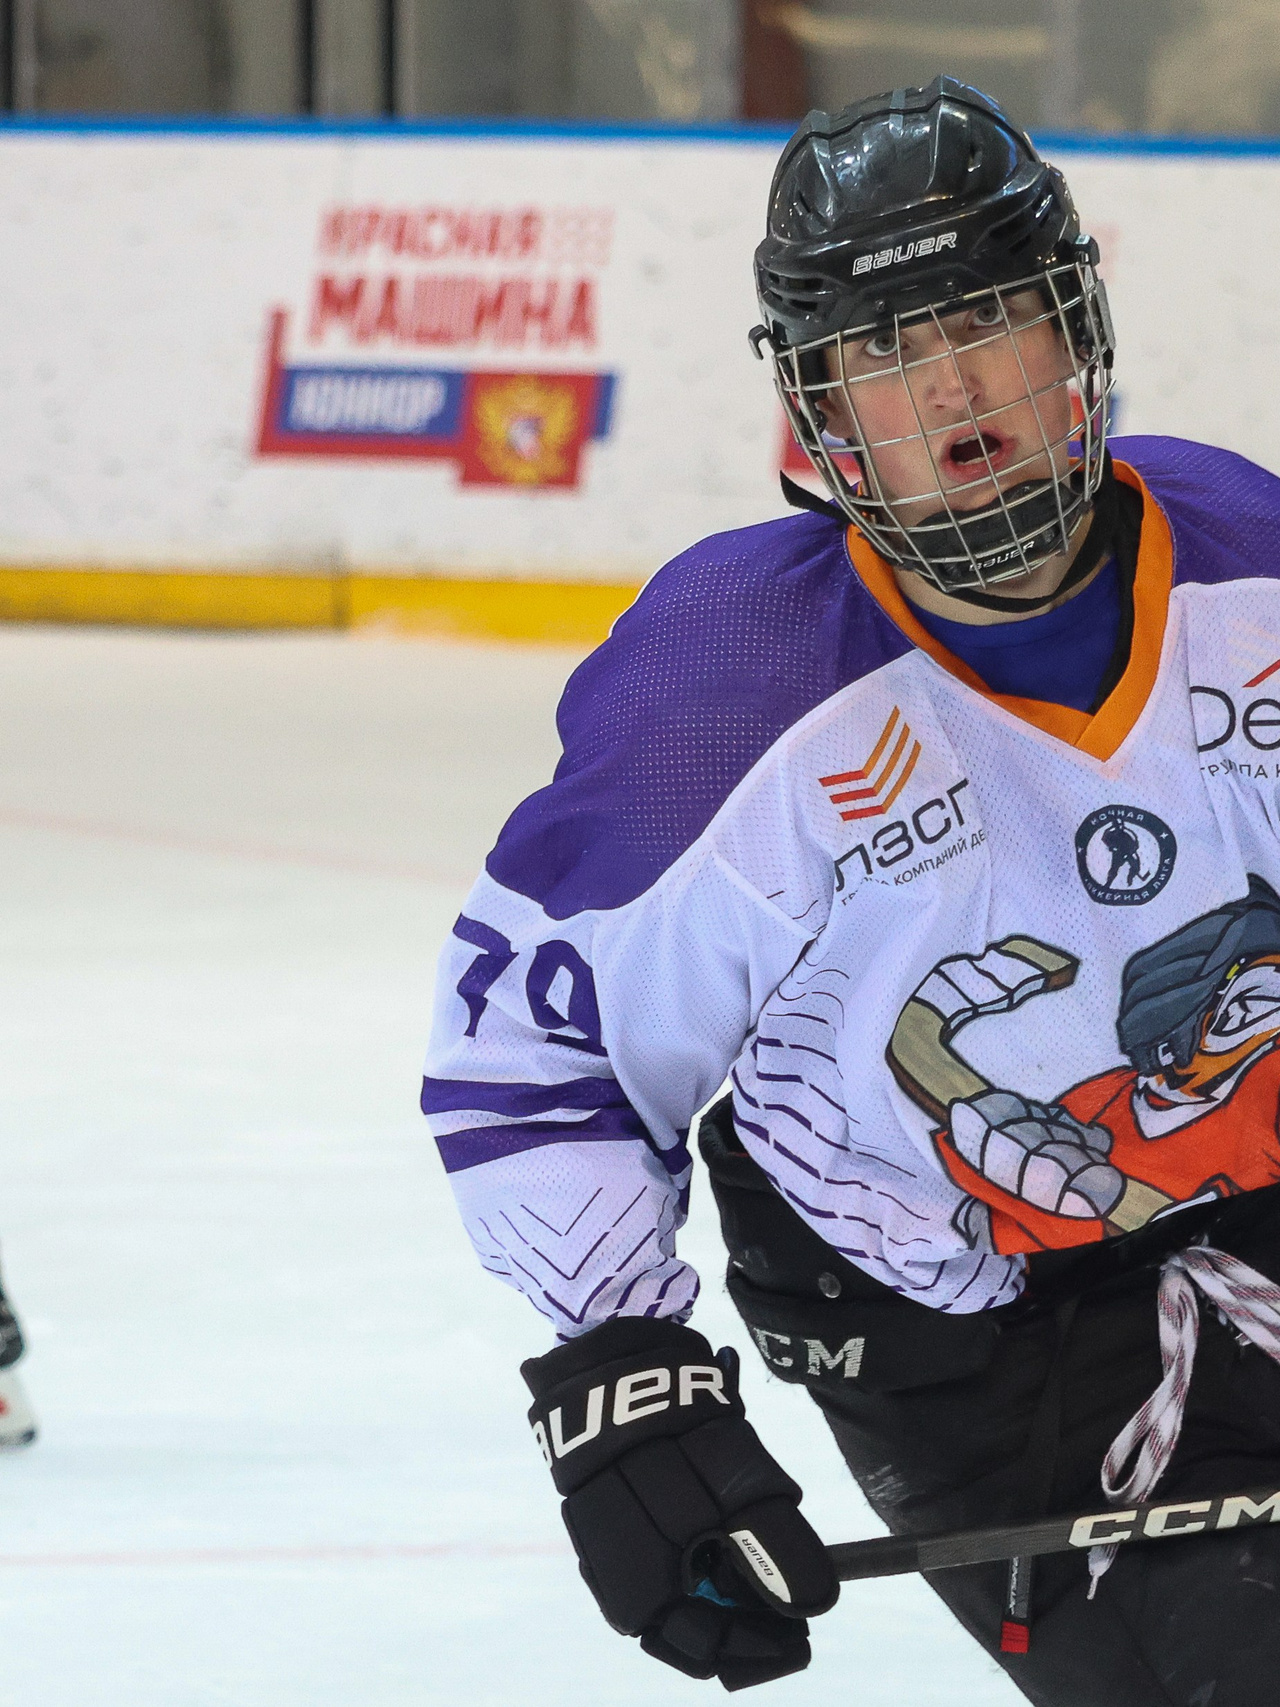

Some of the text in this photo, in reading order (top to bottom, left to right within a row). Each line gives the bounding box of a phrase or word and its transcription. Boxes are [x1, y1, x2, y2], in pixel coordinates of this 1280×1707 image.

[317, 206, 541, 258] КРАСНАЯ
[852, 232, 957, 276] BAUER
[308, 275, 599, 350] МАШИНА
[292, 374, 447, 432] ЮНИОР
[893, 837, 967, 887] КОМПАНИЙ
